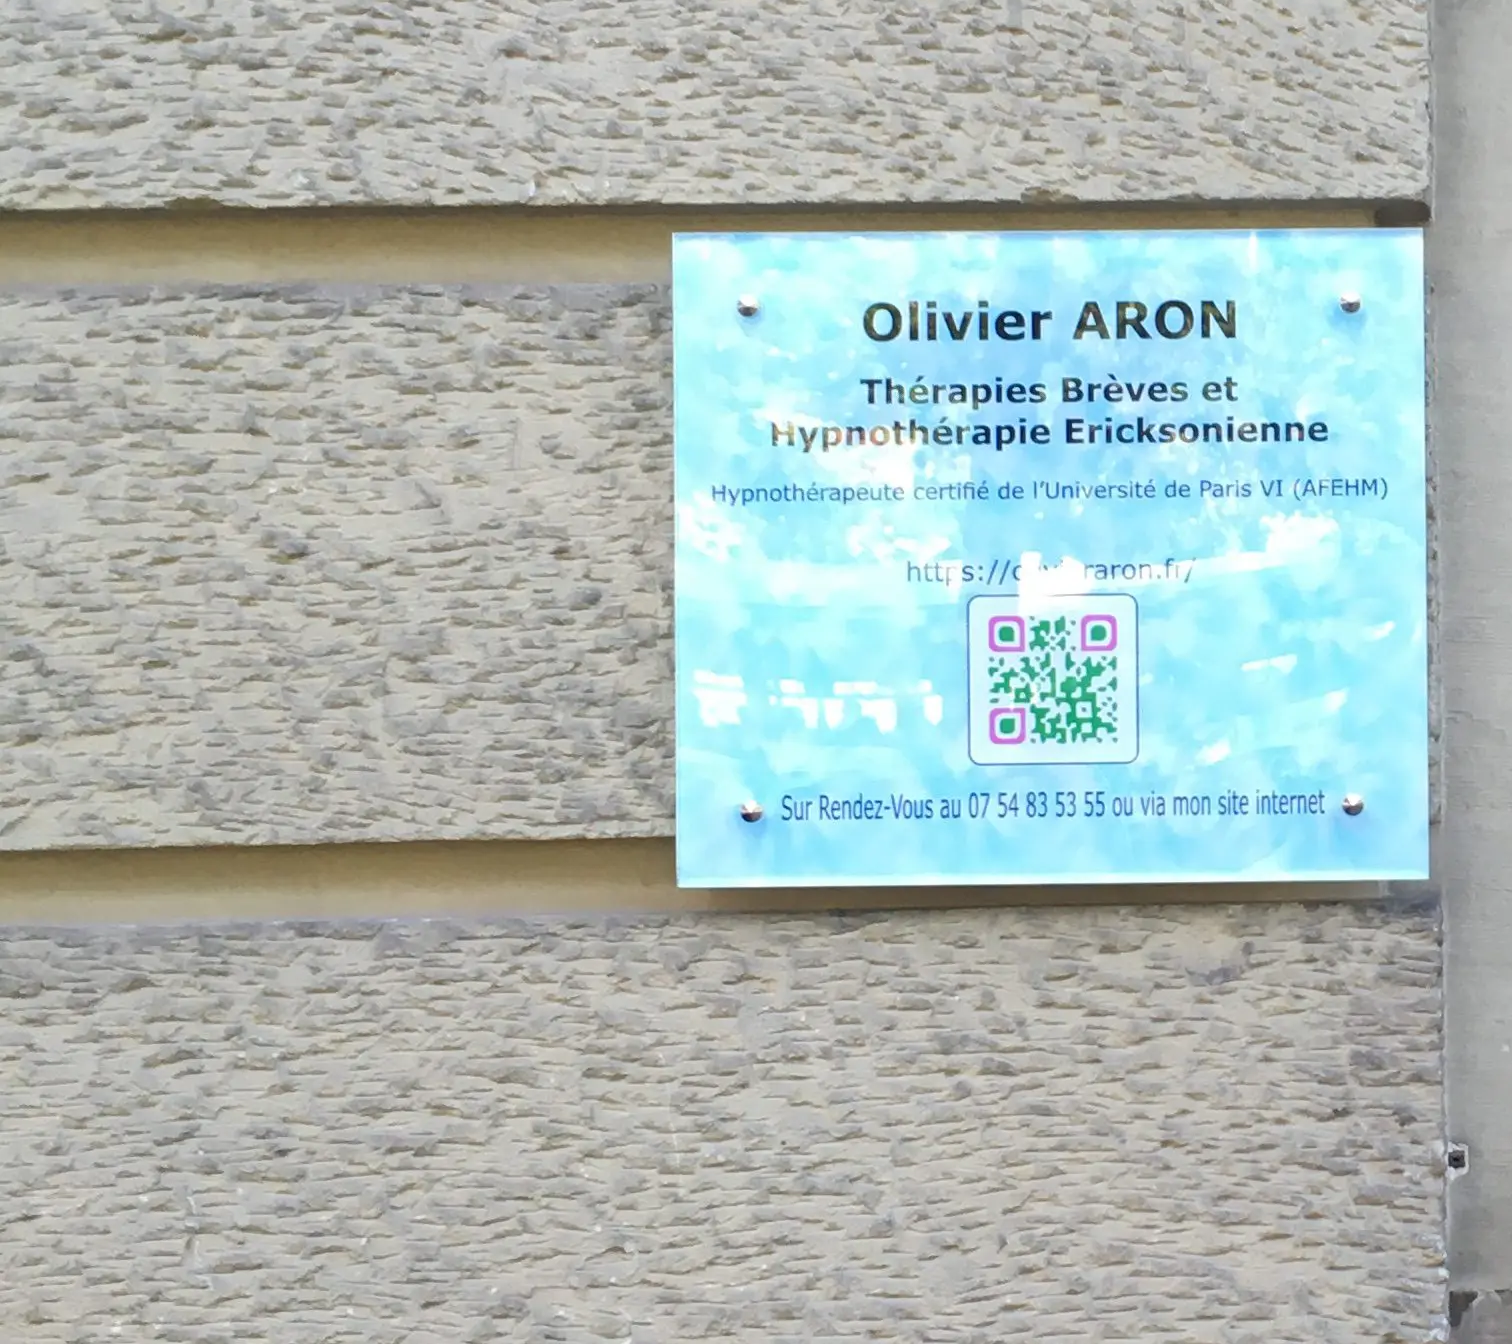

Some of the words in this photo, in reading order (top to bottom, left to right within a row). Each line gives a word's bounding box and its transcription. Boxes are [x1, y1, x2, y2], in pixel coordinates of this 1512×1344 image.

[862, 299, 1053, 343] Olivier
[1071, 299, 1237, 341] ARON
[860, 375, 1047, 410] Thérapies
[1061, 372, 1189, 404] Brèves
[1201, 376, 1239, 403] et
[770, 416, 1051, 453] Hypnothérapie
[1065, 415, 1330, 446] Ericksonienne
[711, 481, 905, 507] Hypnothérapeute
[913, 479, 990, 501] certifié
[997, 481, 1025, 501] de
[1164, 479, 1191, 499] de
[1200, 479, 1252, 499] Paris
[1260, 478, 1284, 498] VI
[1293, 476, 1389, 504] (AFEHM)
[781, 794, 812, 821] Sur
[819, 792, 935, 821] Rendez-Vous
[939, 798, 962, 820] au
[967, 791, 991, 820] 07
[997, 791, 1020, 819] 54
[1025, 790, 1048, 818] 83
[1055, 790, 1077, 818] 53
[1083, 790, 1106, 817] 55
[1111, 796, 1134, 818] ou
[1140, 789, 1166, 817] via
[1172, 794, 1212, 817] mon
[1217, 789, 1250, 816] site
[1255, 788, 1326, 816] internet
